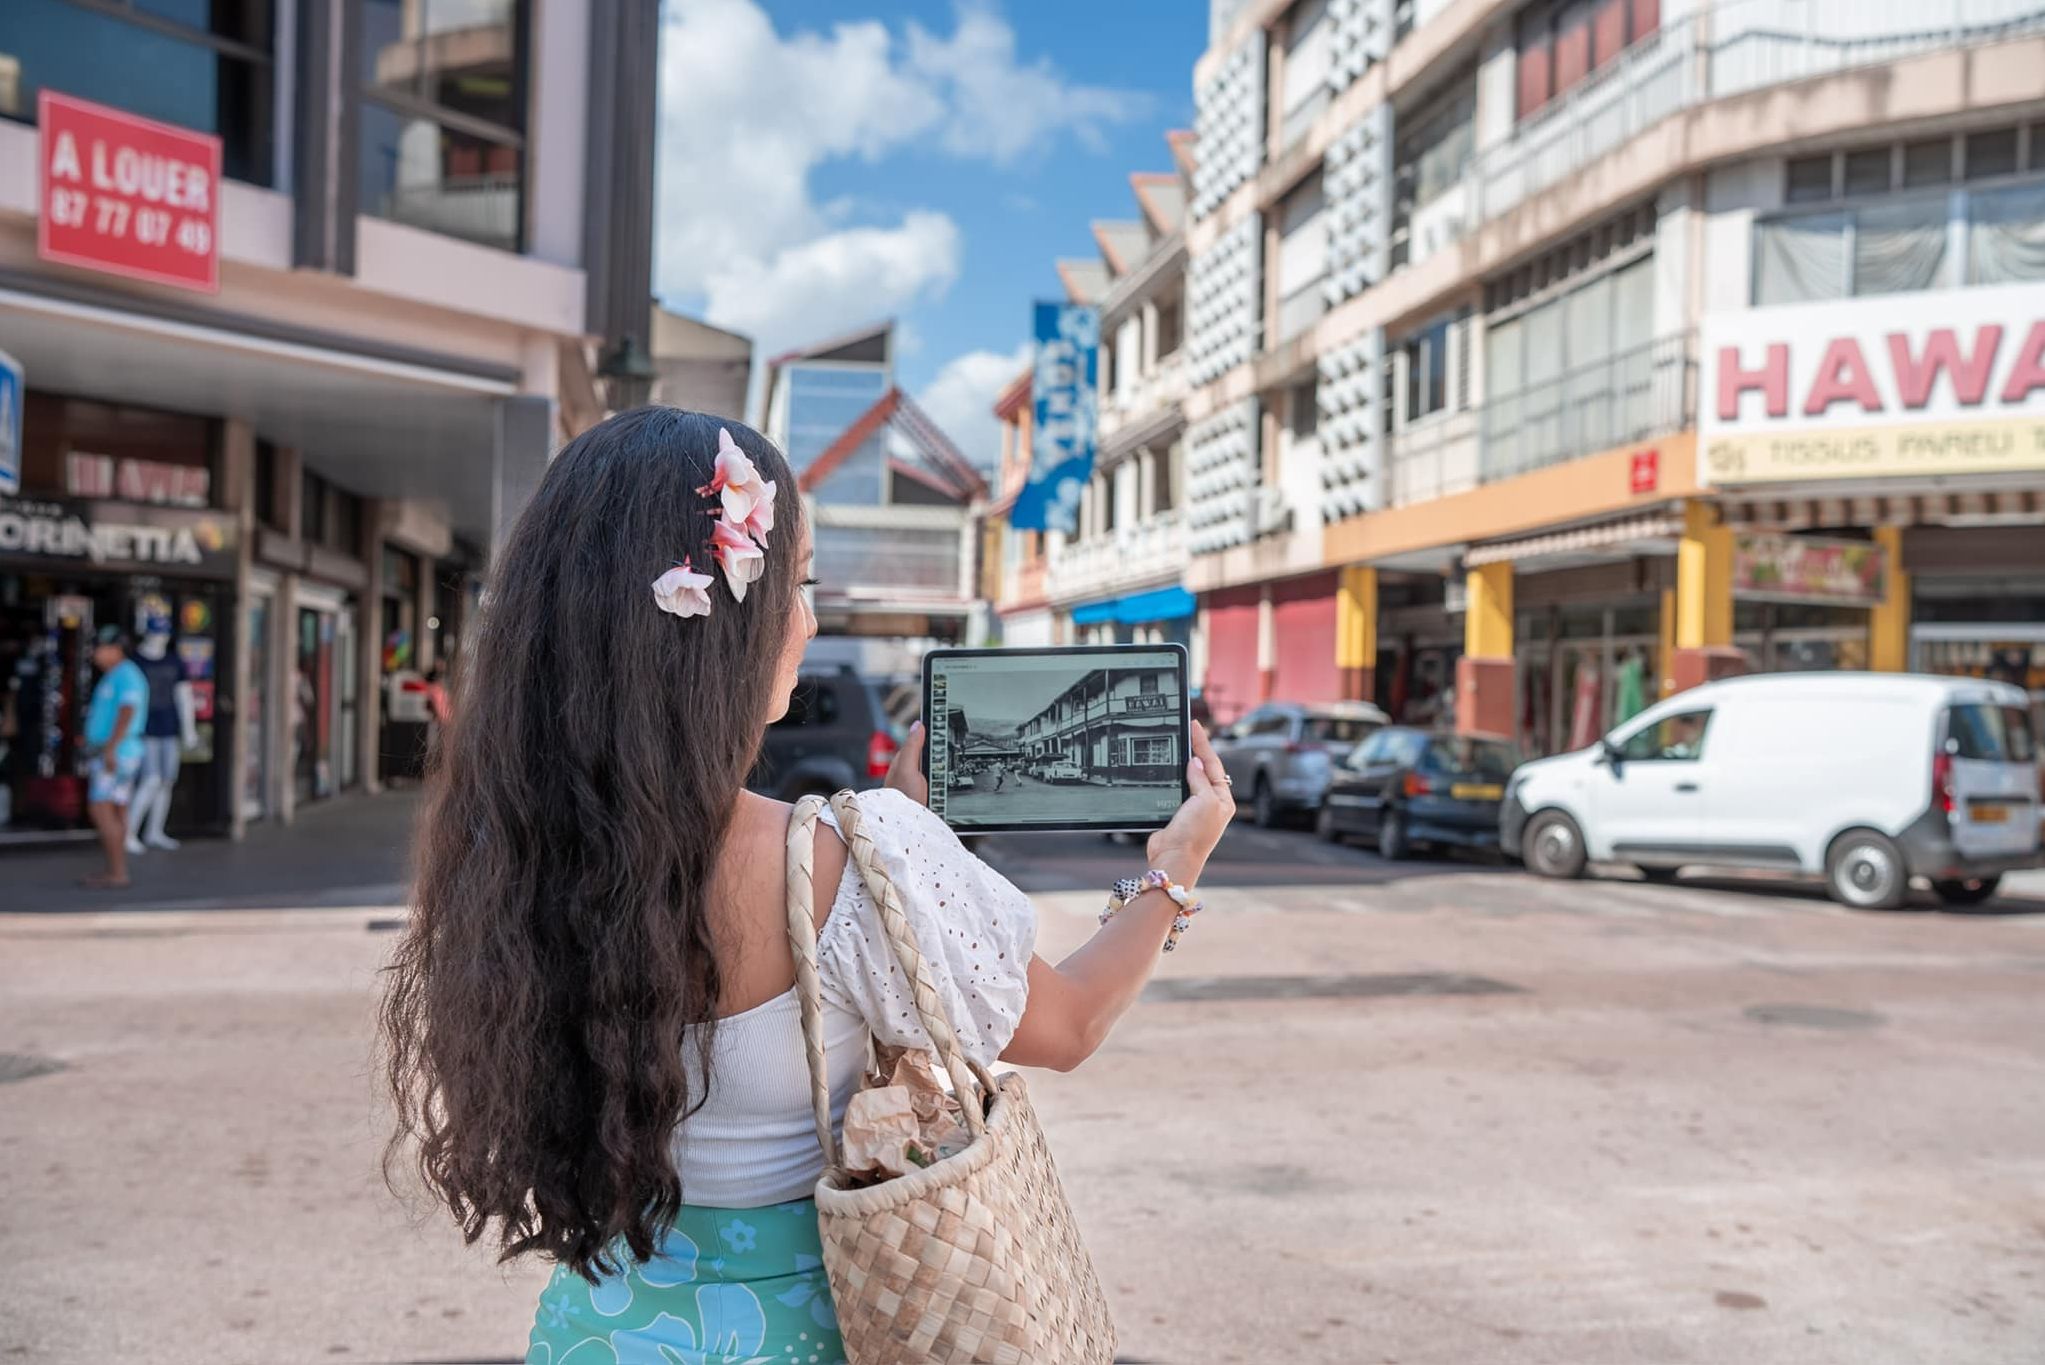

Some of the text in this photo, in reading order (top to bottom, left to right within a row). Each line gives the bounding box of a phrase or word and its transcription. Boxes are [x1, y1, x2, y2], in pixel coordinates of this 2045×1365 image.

[52, 130, 209, 213] A LOUER
[96, 195, 130, 238] 77
[1770, 435, 1879, 465] TISSUS
[1898, 428, 2015, 459] PAREU
